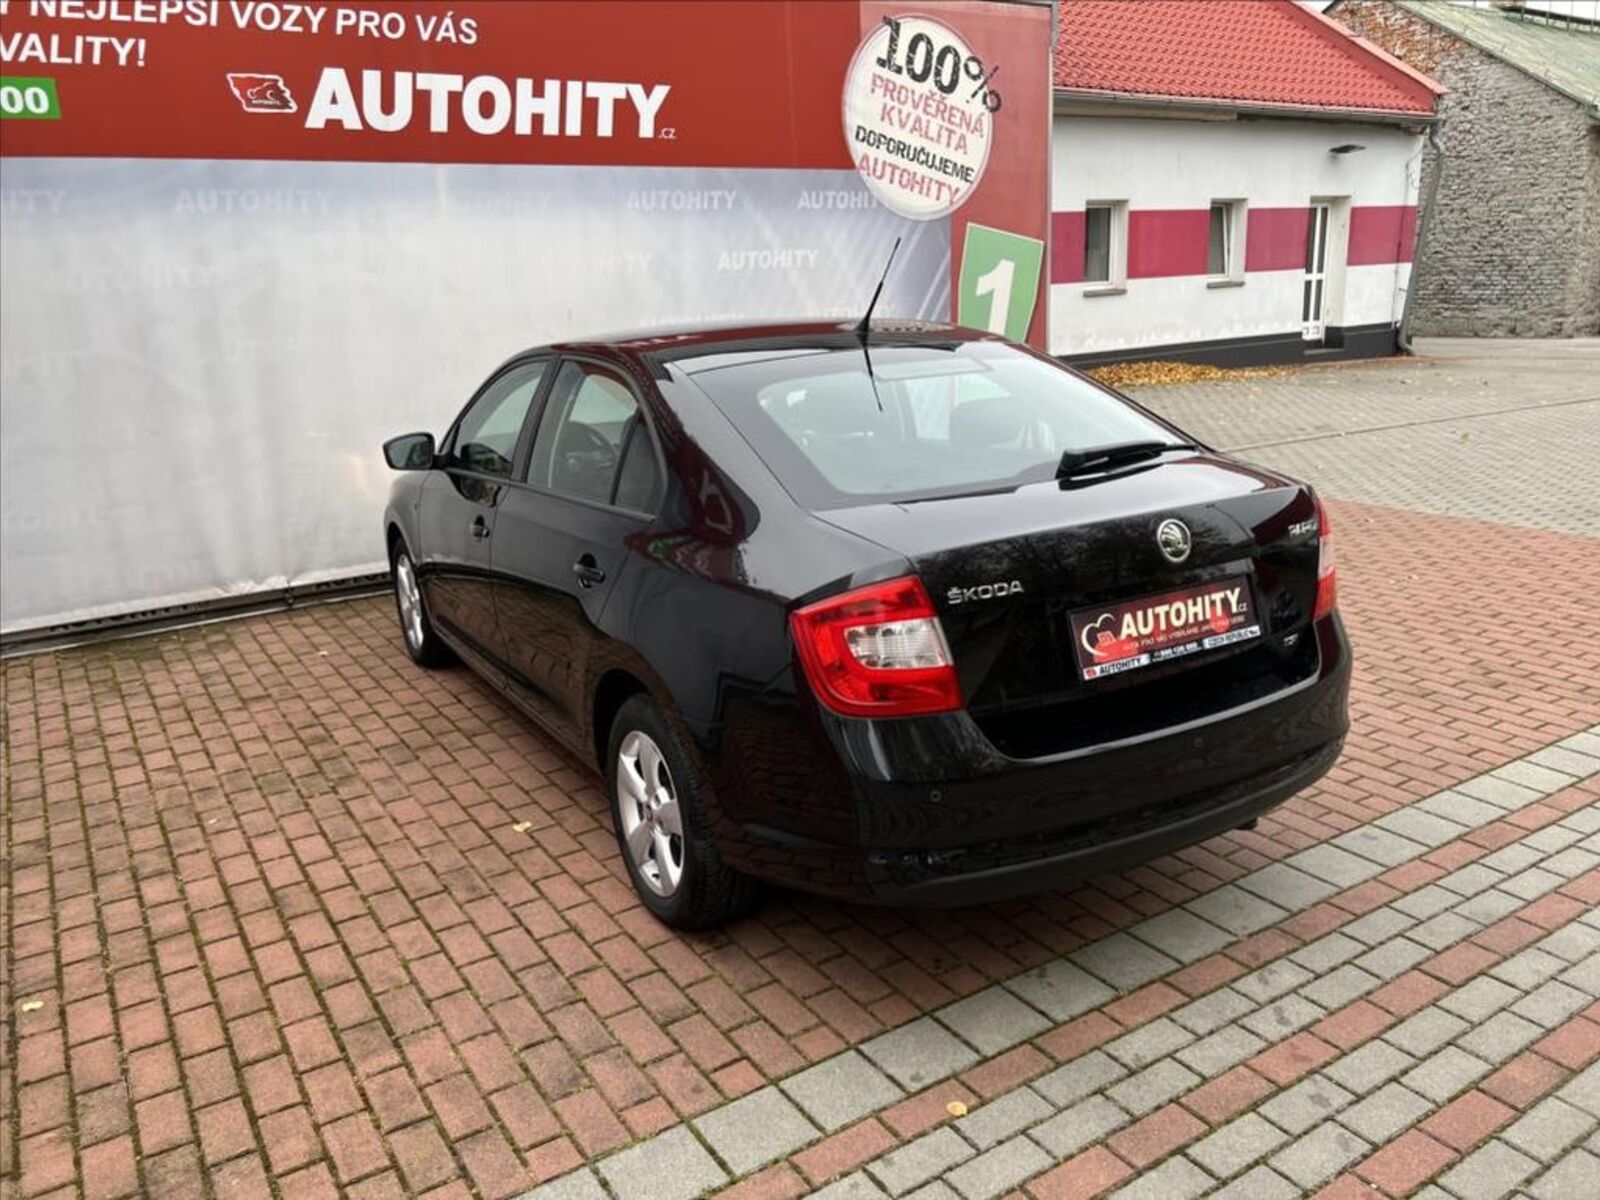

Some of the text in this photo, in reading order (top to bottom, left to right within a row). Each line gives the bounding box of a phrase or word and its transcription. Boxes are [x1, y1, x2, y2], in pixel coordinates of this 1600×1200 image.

[231, 1, 327, 34] VOZY
[336, 9, 406, 39] PRO
[416, 11, 478, 45] VÁS
[876, 16, 1002, 113] 100%
[871, 72, 985, 138] PROVĚŘENÁ
[880, 102, 969, 155] KVALITA
[855, 124, 975, 184] DOPORUČUJEME
[858, 152, 961, 202] AUTOHITY
[174, 188, 330, 214] AUTOHITY
[627, 190, 737, 211] AUTOHITY
[717, 249, 819, 272] AUTOHITY
[975, 259, 1016, 335] 1
[947, 580, 1024, 605] ŠKODA
